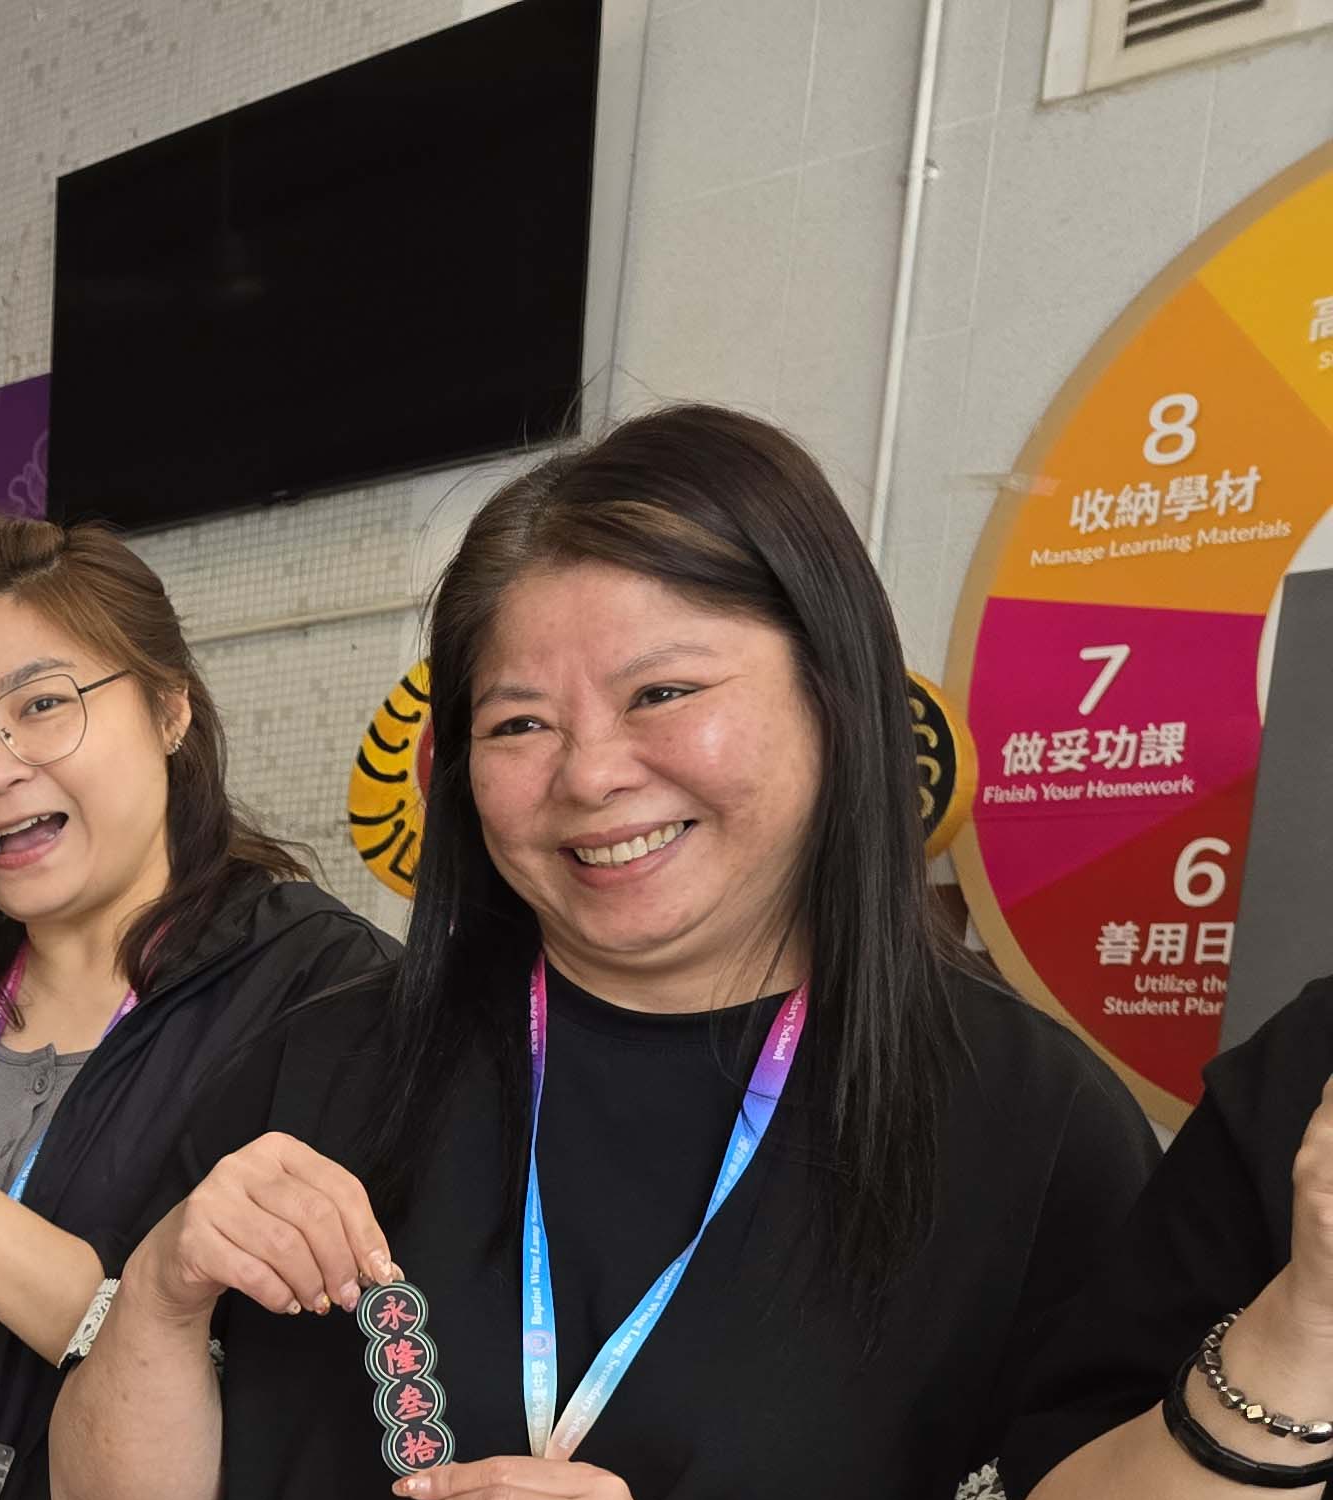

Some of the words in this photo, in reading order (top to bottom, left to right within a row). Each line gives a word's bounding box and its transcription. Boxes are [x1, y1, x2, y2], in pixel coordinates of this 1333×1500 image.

[1143, 392, 1199, 465] 8
[1069, 465, 1261, 534] 收納學材
[1031, 545, 1106, 567] Manage
[1109, 532, 1192, 557] Learning
[1197, 519, 1292, 547] Materials
[1078, 644, 1130, 715] 7
[1001, 721, 1187, 776] 做妥功課
[983, 783, 1037, 803] Finish
[1041, 782, 1084, 801] Your
[1086, 774, 1195, 799] Homework
[1173, 837, 1231, 907] 6
[1103, 996, 1180, 1016] Student
[1134, 974, 1197, 993] Utilize
